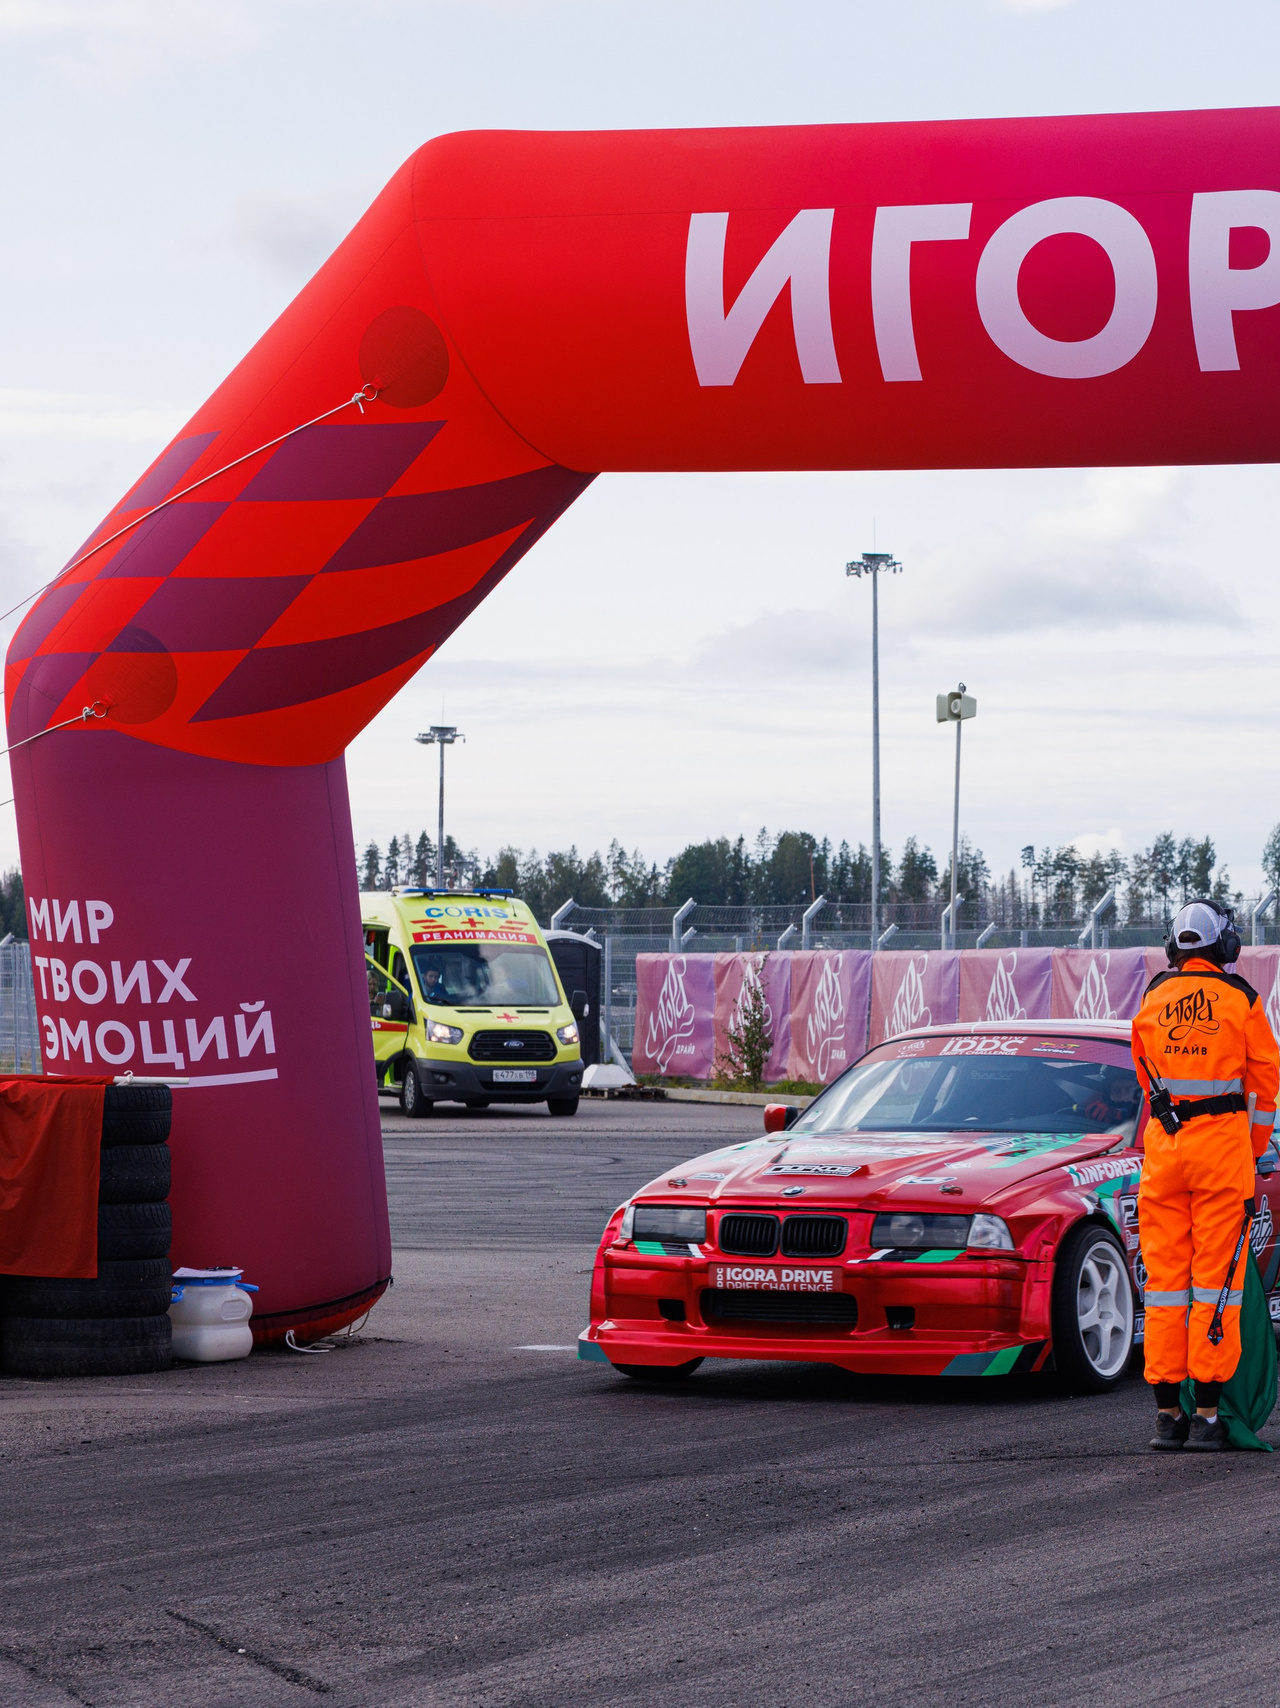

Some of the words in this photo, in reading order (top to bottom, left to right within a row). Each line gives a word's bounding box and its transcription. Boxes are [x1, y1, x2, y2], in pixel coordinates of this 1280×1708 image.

[29, 896, 114, 944] МИР
[425, 906, 509, 919] CORIS
[422, 931, 528, 942] РЕАНИМАЦИЯ
[34, 955, 198, 1005] ТВОИХ
[42, 1000, 276, 1070] ЭМОЦИЙ
[943, 1040, 1025, 1052] IDDC
[1164, 1044, 1208, 1055] ДРАЙВ
[726, 1267, 778, 1282] IGORA
[781, 1269, 833, 1284] DRIVE
